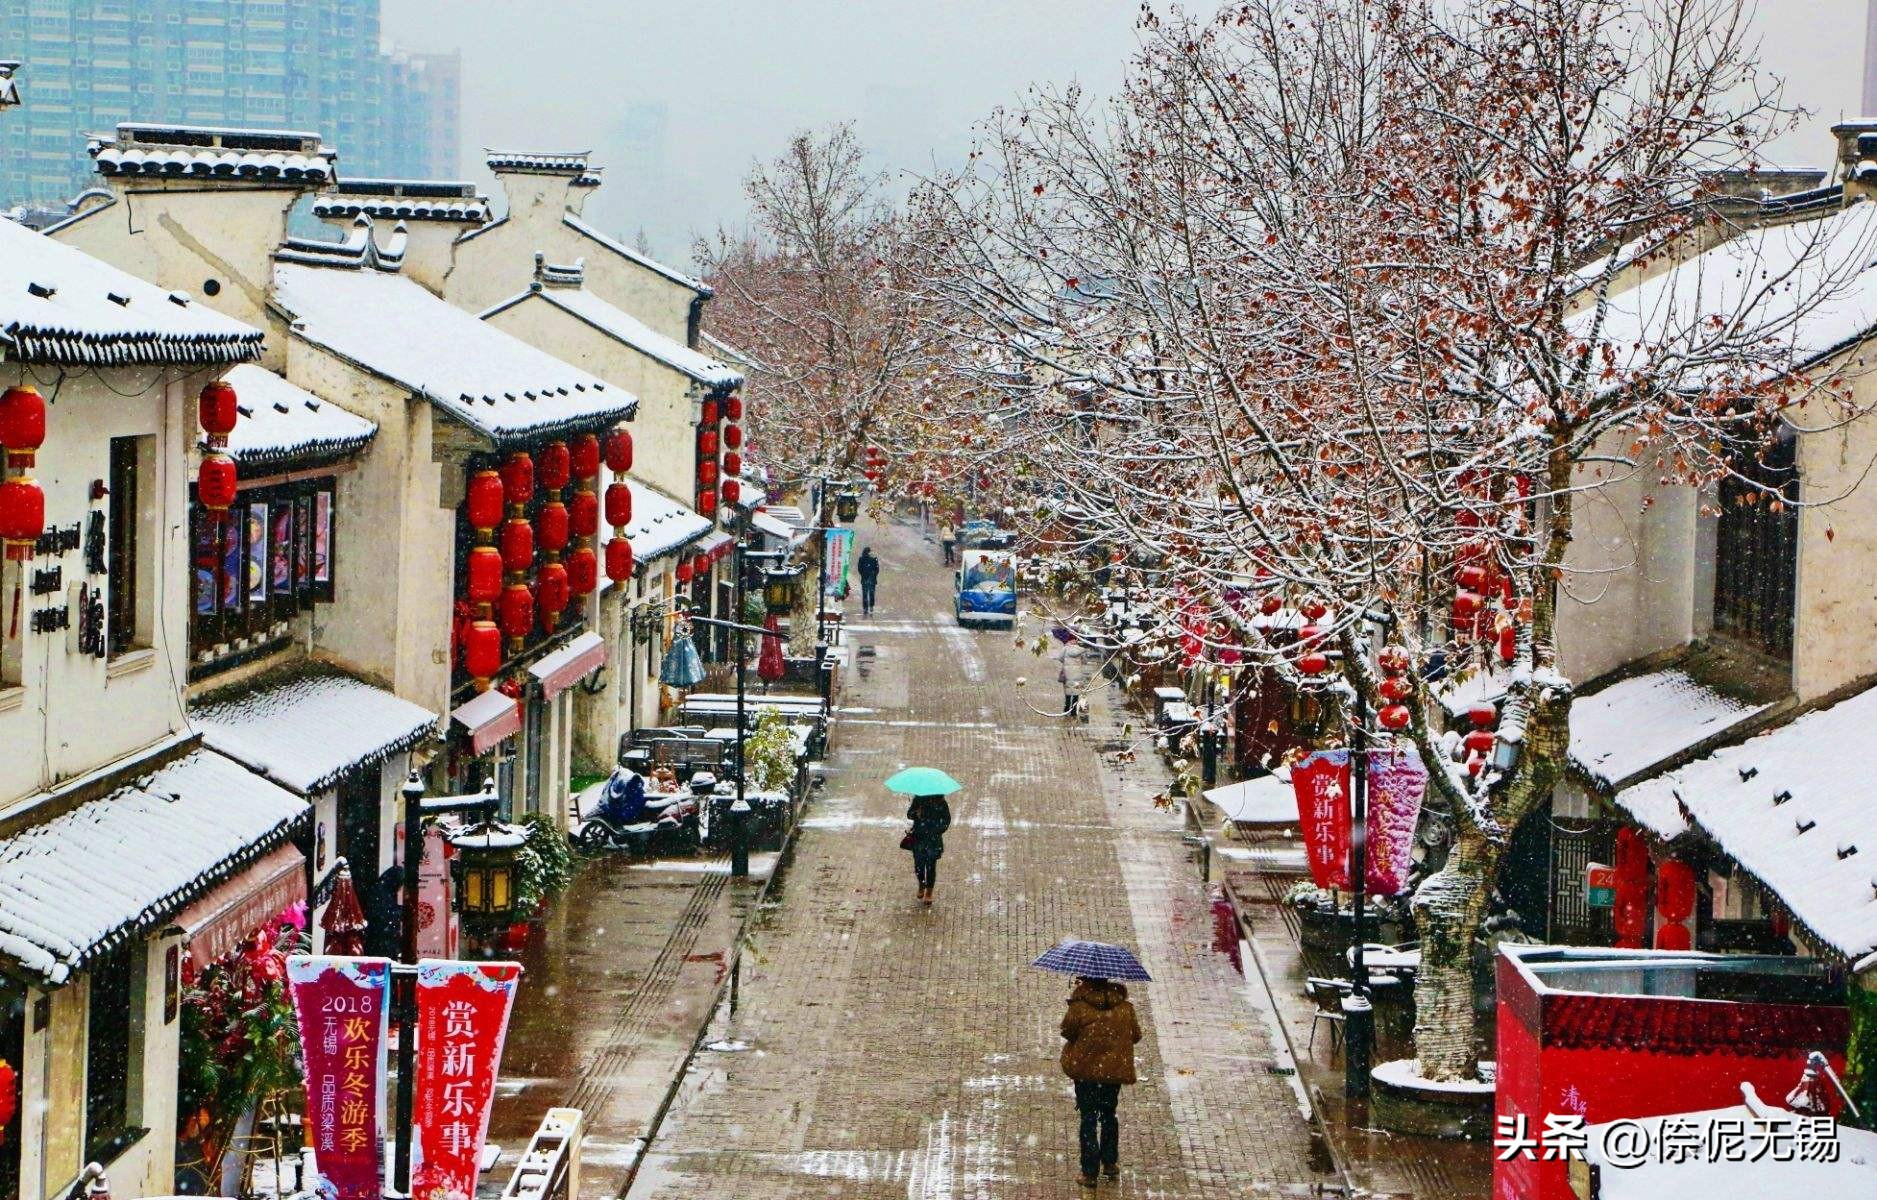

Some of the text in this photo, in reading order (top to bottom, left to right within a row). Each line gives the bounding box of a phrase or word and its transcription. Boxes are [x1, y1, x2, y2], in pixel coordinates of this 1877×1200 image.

[1311, 773, 1336, 865] 赏新乐事
[321, 995, 373, 1014] 2018
[339, 1016, 372, 1153] 欢乐冬游季
[438, 999, 479, 1158] 赏新乐事
